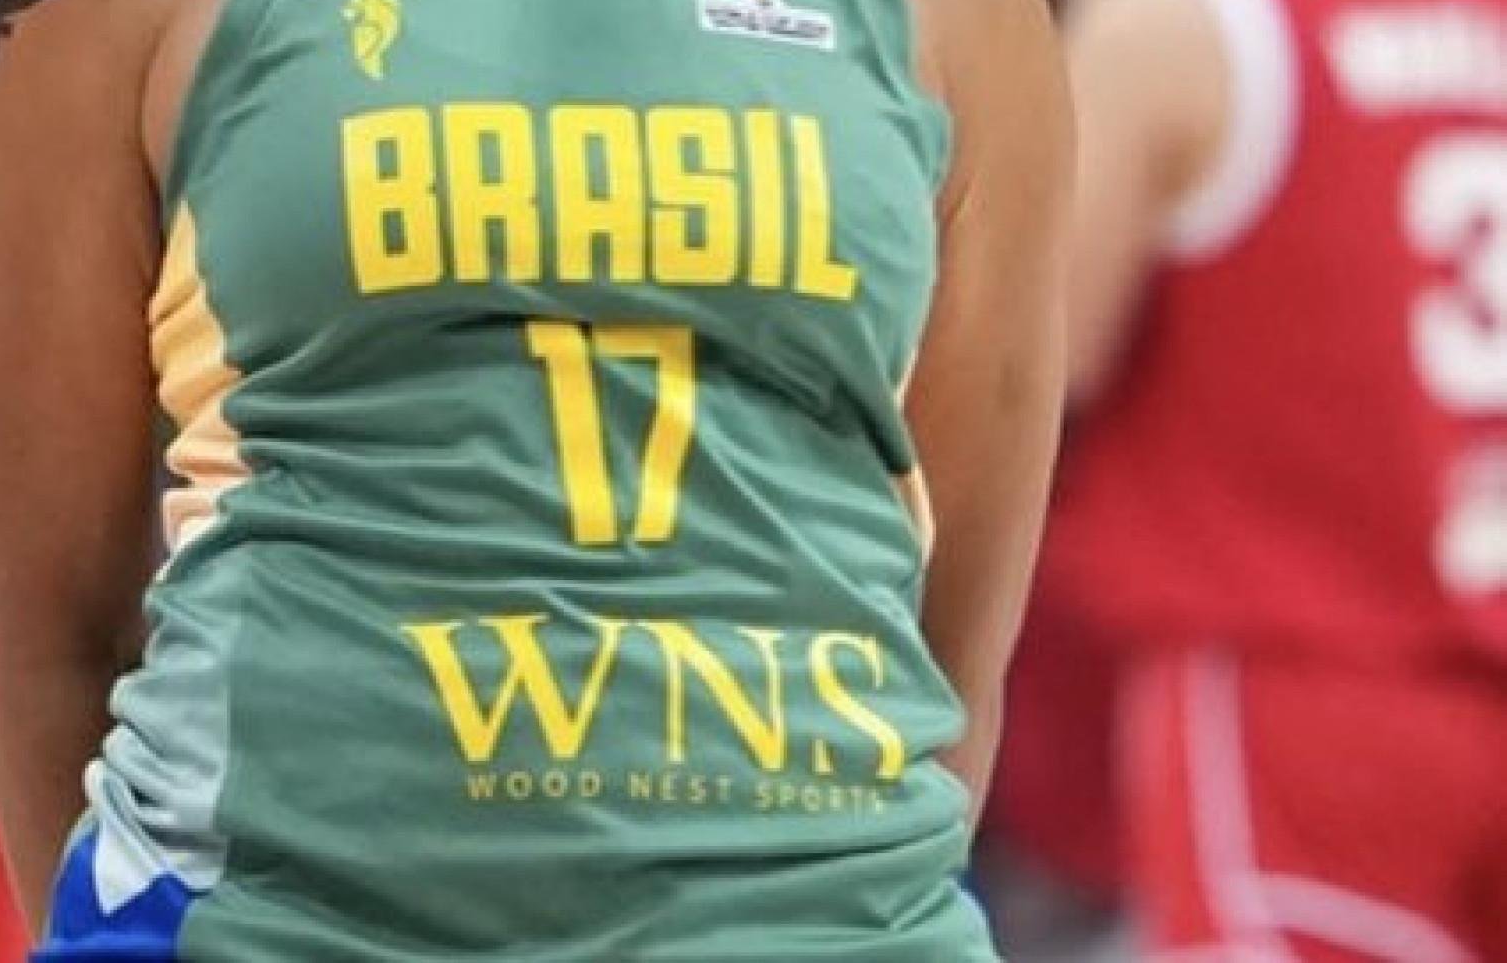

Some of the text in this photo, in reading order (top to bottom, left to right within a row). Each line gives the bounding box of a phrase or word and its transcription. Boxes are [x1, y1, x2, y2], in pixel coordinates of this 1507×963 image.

[340, 101, 858, 301] BRASIL
[524, 319, 696, 543] 17
[397, 612, 905, 779] WNS
[466, 768, 602, 801] WOOD
[628, 771, 735, 805] NEST
